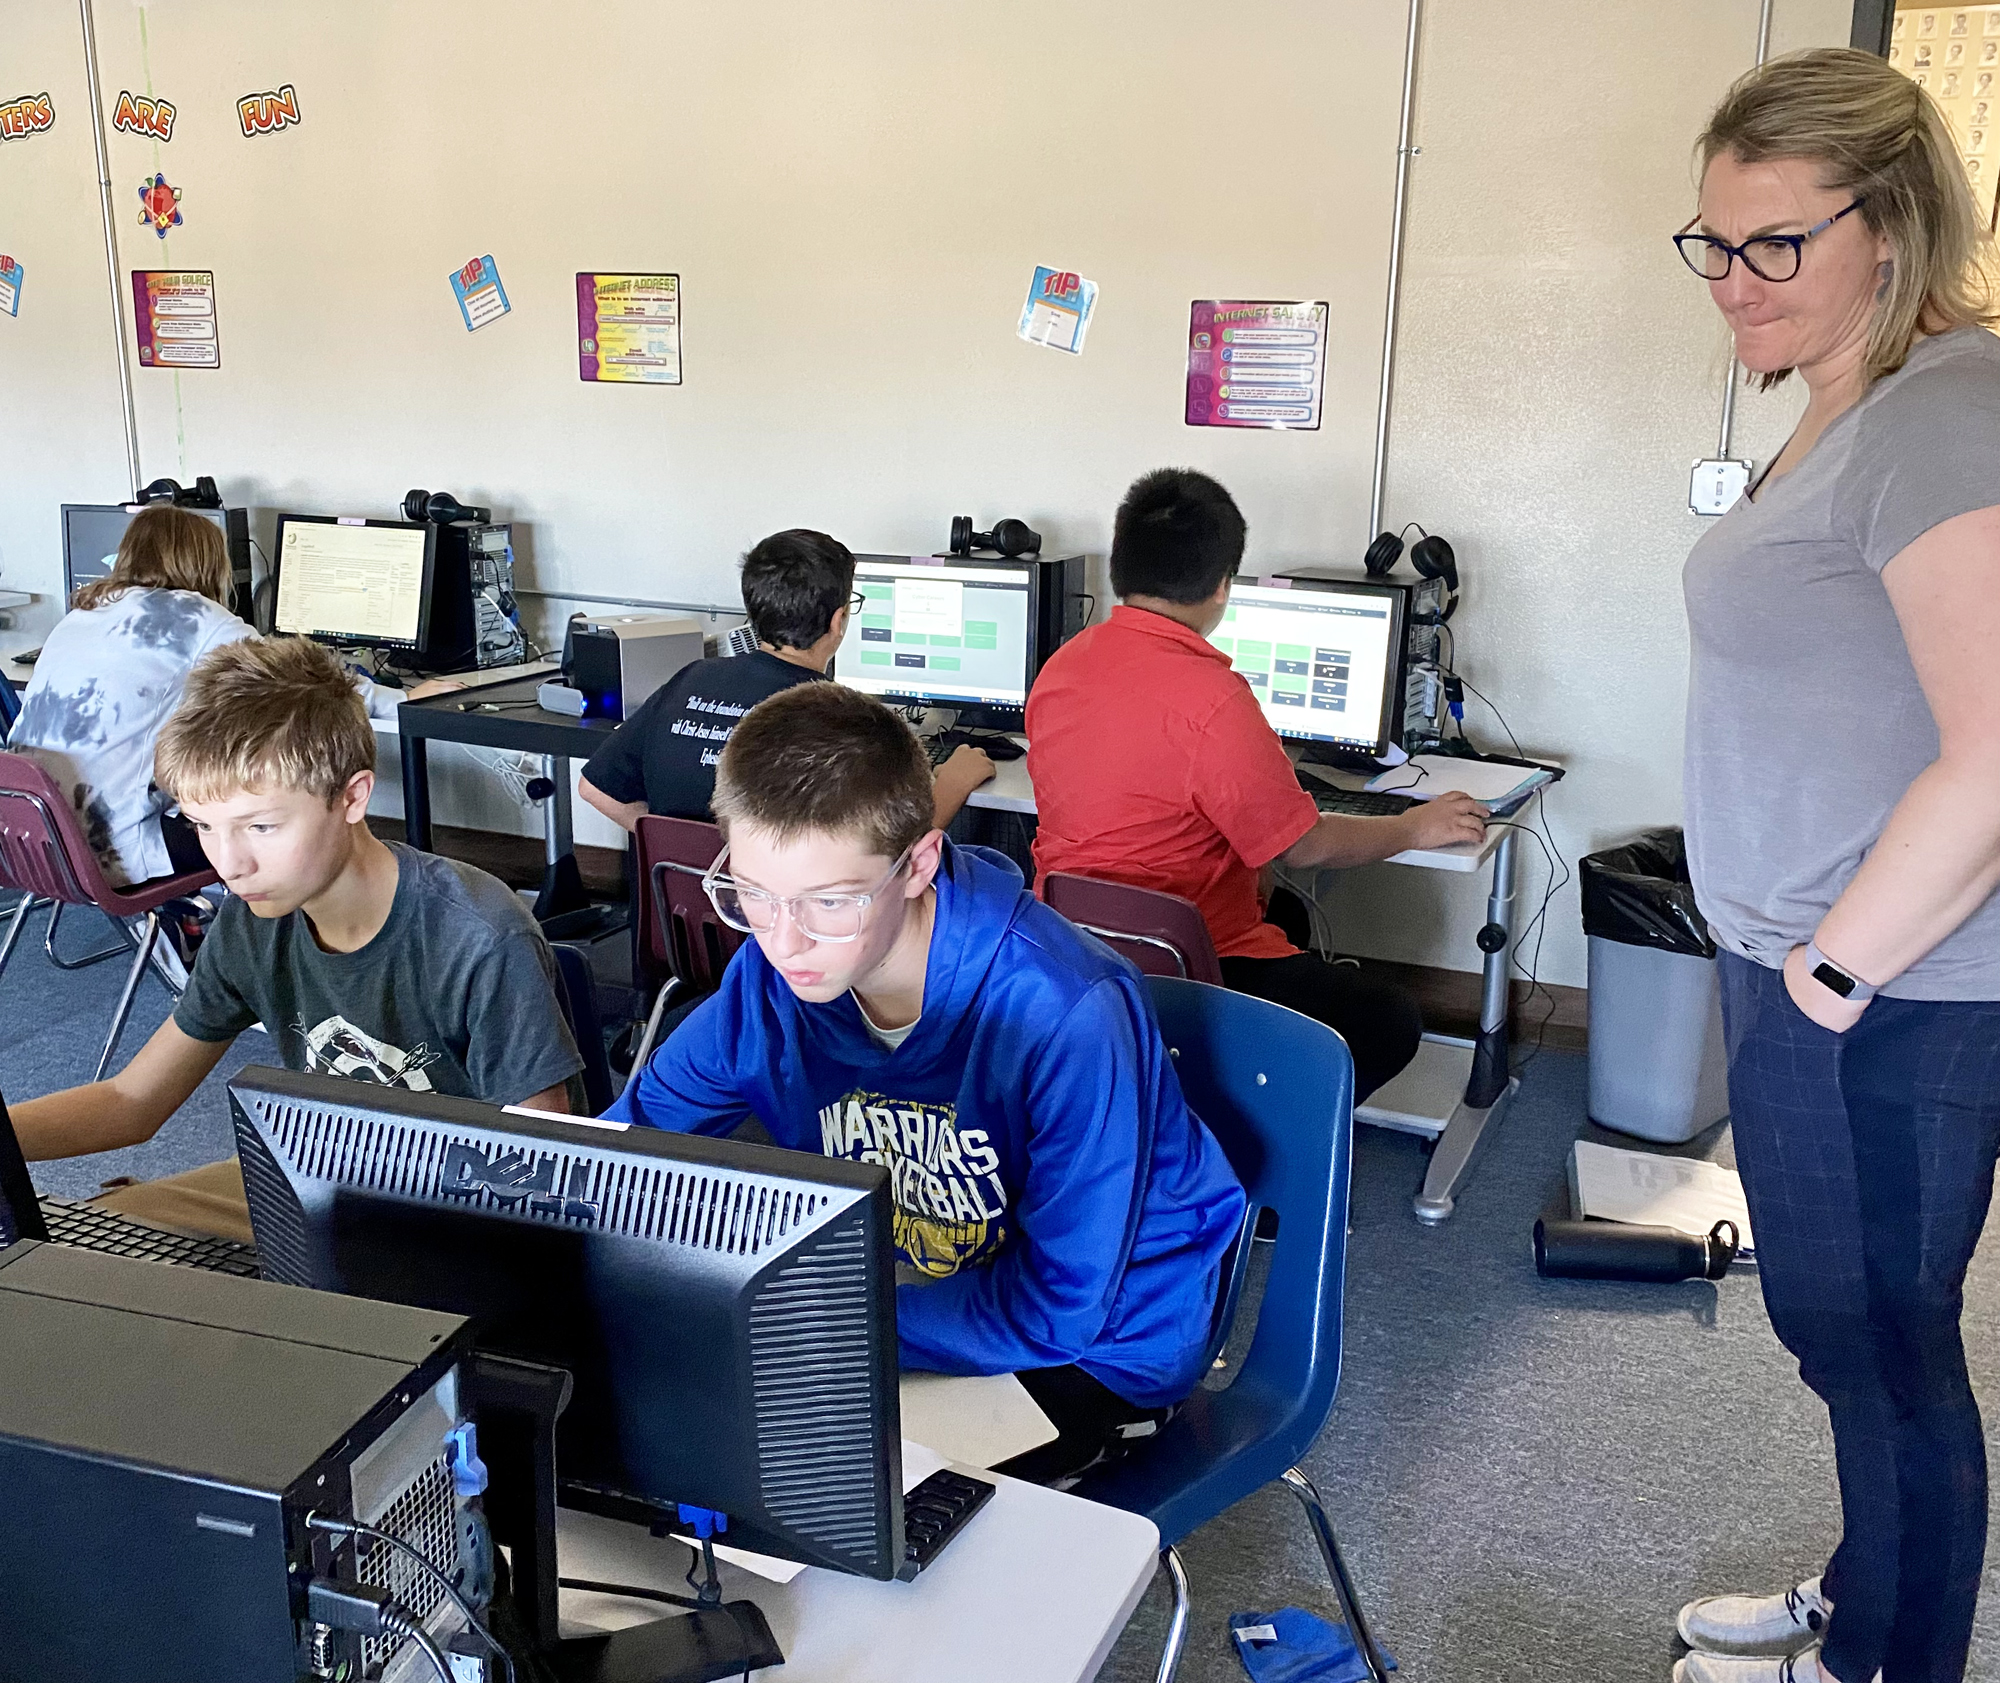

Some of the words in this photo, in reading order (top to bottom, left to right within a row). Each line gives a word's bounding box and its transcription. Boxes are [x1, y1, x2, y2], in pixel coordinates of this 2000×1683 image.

[115, 95, 173, 138] ARE
[240, 90, 297, 133] FUN
[0, 254, 15, 272] IP
[459, 257, 483, 291] TIP
[182, 274, 211, 286] SOURCE
[633, 277, 676, 293] ADDRESS
[1043, 271, 1081, 297] TIP
[1213, 307, 1269, 323] INTERNET
[441, 1143, 600, 1220] DELL
